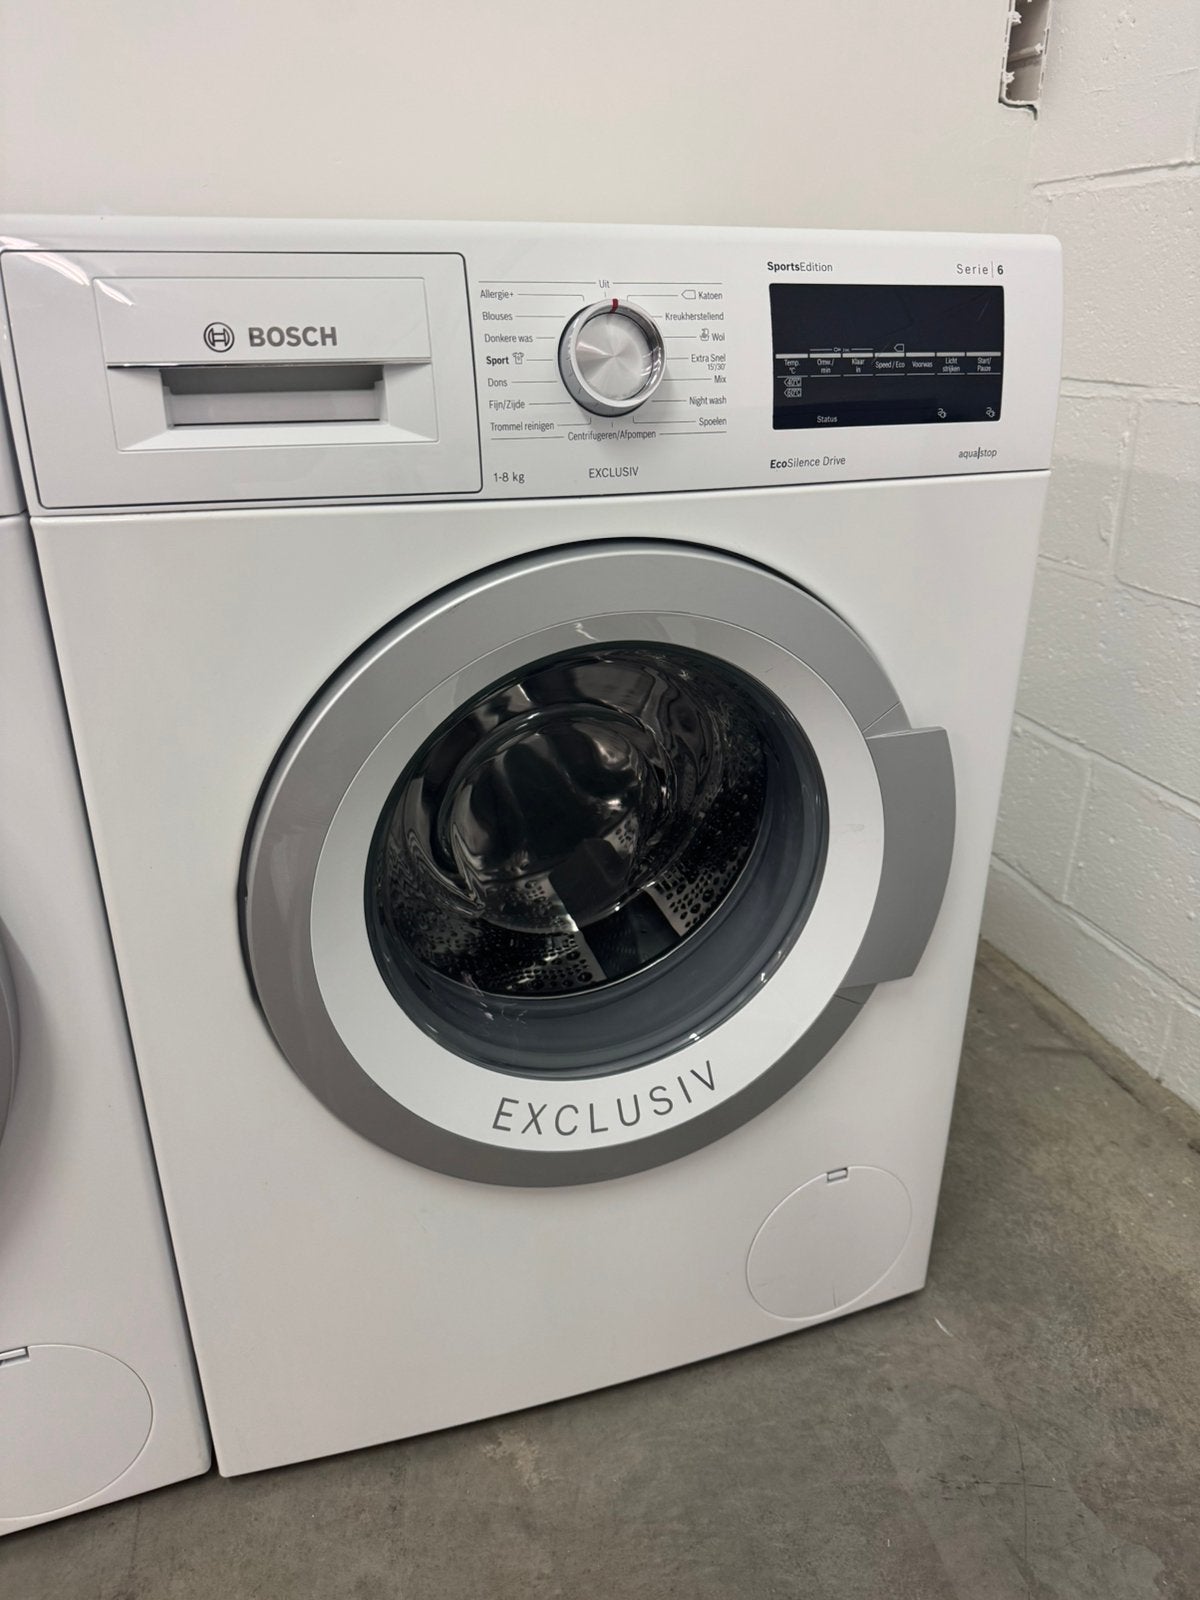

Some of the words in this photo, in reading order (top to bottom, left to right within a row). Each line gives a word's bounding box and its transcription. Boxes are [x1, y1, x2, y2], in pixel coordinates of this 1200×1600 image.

[767, 261, 833, 273] SportsEdition
[956, 263, 989, 275] Serie
[599, 280, 610, 289] Uit
[480, 290, 514, 301] Allergie+
[698, 291, 723, 300] Katoen
[482, 312, 513, 321] Blouses
[665, 312, 724, 321] Kreukherstellend
[248, 326, 337, 348] BOSCH
[484, 334, 516, 343] Donkere
[518, 335, 533, 343] was
[711, 333, 725, 342] Wol
[486, 356, 509, 367] Sport
[691, 353, 709, 363] Extra
[710, 353, 726, 362] Snel
[851, 358, 865, 366] Klaar
[945, 357, 958, 365] Licht
[912, 361, 933, 369] Voorwas
[487, 378, 508, 387] Dons
[714, 375, 727, 383] Mix
[489, 400, 525, 410] Fijn/Zijde
[689, 396, 708, 407] Night
[708, 396, 727, 405] wash
[699, 416, 727, 428] Spoelen
[816, 415, 838, 424] Status
[490, 421, 523, 431] Trommel
[524, 421, 554, 432] reinigen
[567, 428, 656, 442] Centrifugeren/Afpompen
[770, 457, 820, 470] EcoSilence
[822, 455, 846, 466] Drive
[588, 465, 639, 479] EXCLUSIV
[493, 472, 509, 482] 1-8
[512, 471, 525, 484] kg
[492, 1060, 715, 1136] EXCLUSIV
